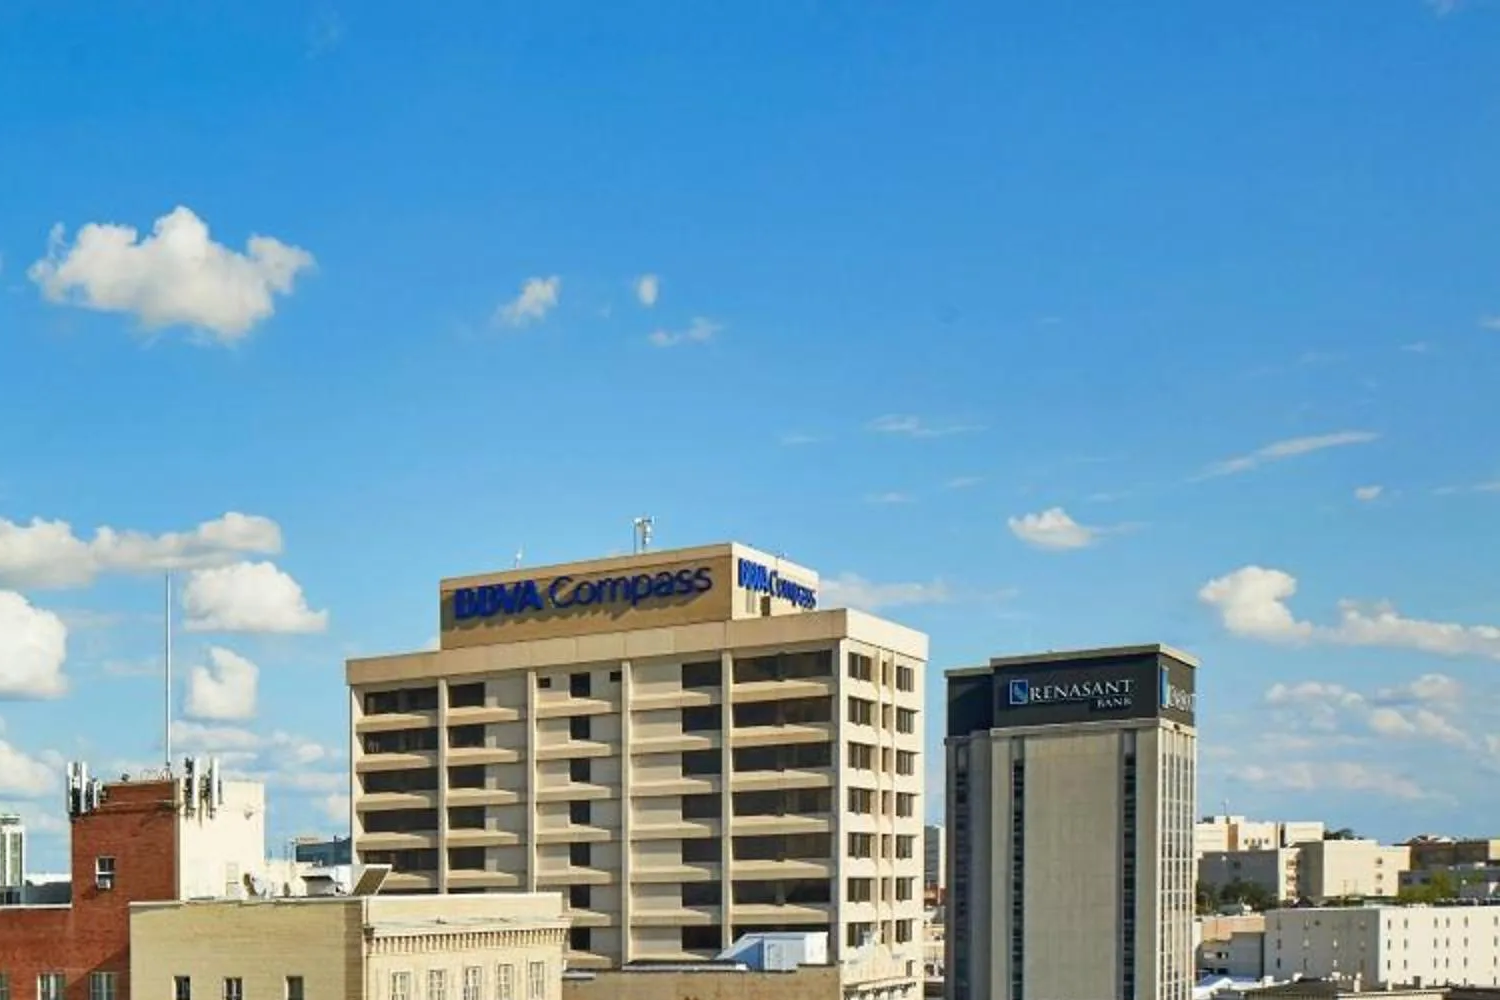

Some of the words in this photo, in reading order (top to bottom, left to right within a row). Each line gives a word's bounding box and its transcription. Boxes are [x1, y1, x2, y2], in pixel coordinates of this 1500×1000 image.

[455, 579, 543, 619] BBVA
[548, 567, 712, 608] Compass
[1029, 679, 1134, 701] RENASANT
[1097, 697, 1132, 709] BANK
